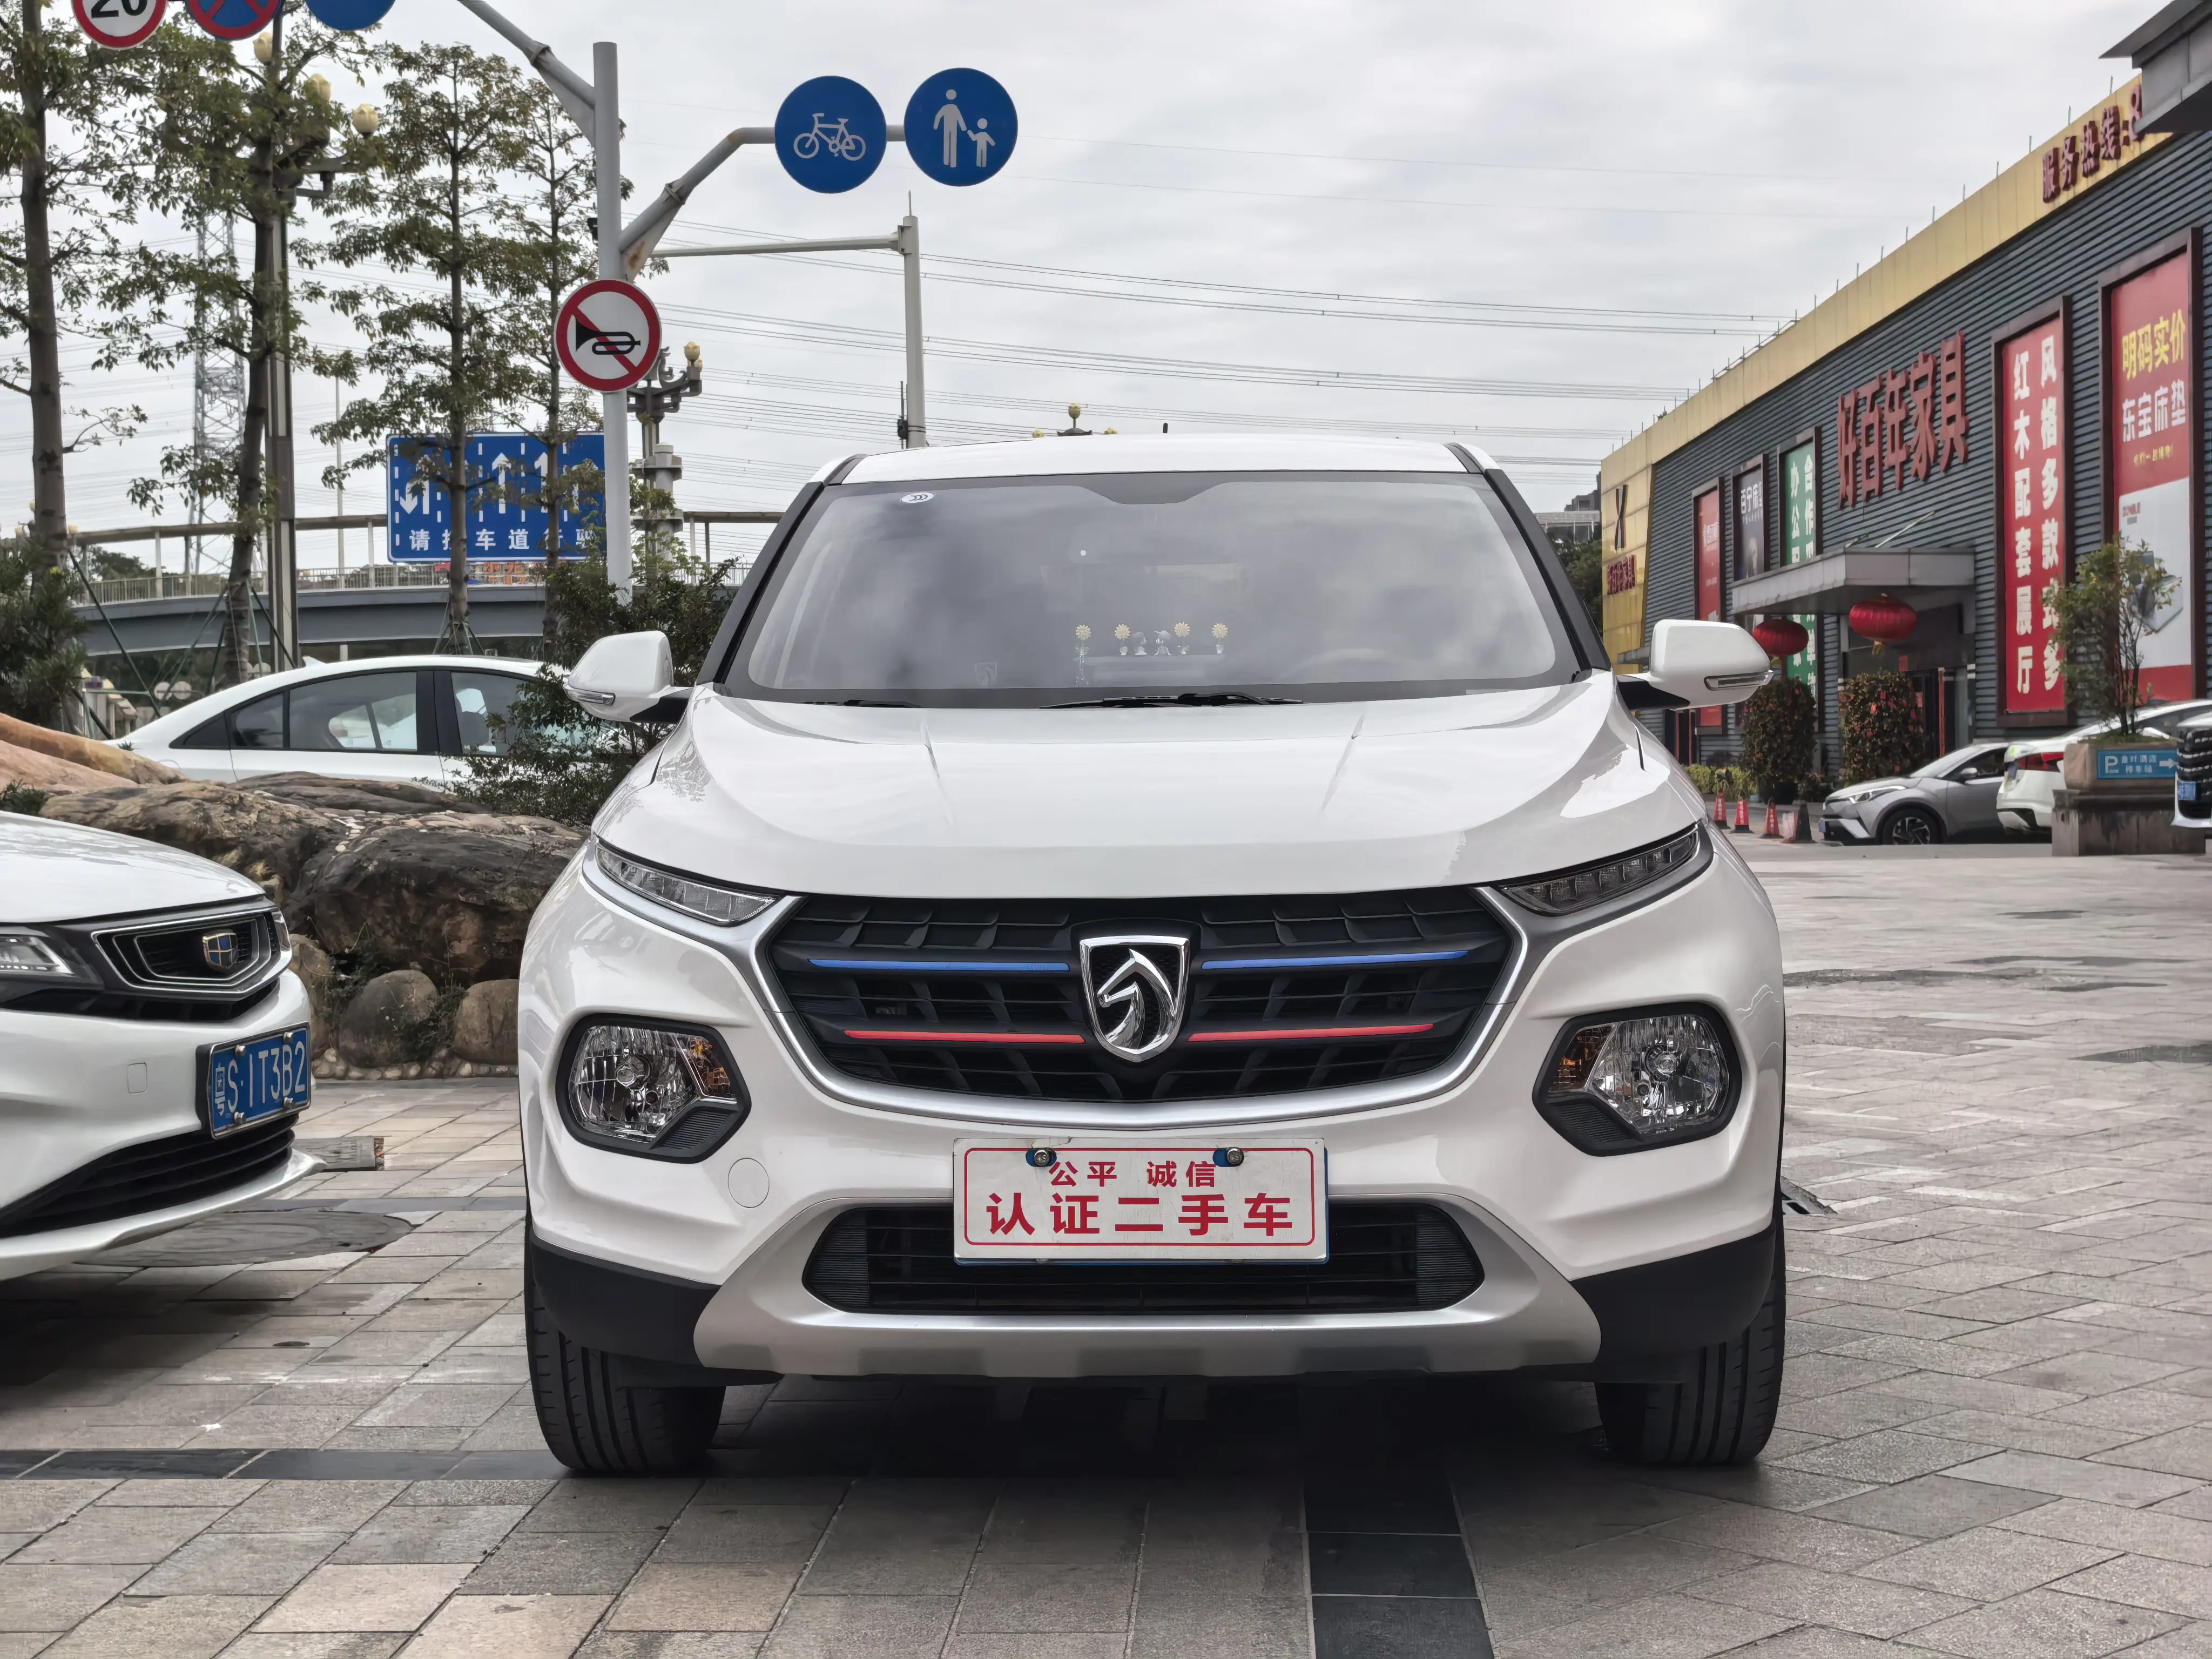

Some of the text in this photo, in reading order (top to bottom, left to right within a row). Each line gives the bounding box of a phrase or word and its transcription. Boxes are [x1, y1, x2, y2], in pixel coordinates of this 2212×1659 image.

[2122, 308, 2186, 380] 明码实价
[1837, 330, 1969, 510] 好百年家具
[2122, 379, 2186, 442] 东宝床垫
[2014, 350, 2033, 693] 红木配套展厅
[1048, 1161, 1216, 1188] 公平 诚信
[986, 1192, 1292, 1236] 认证二手车
